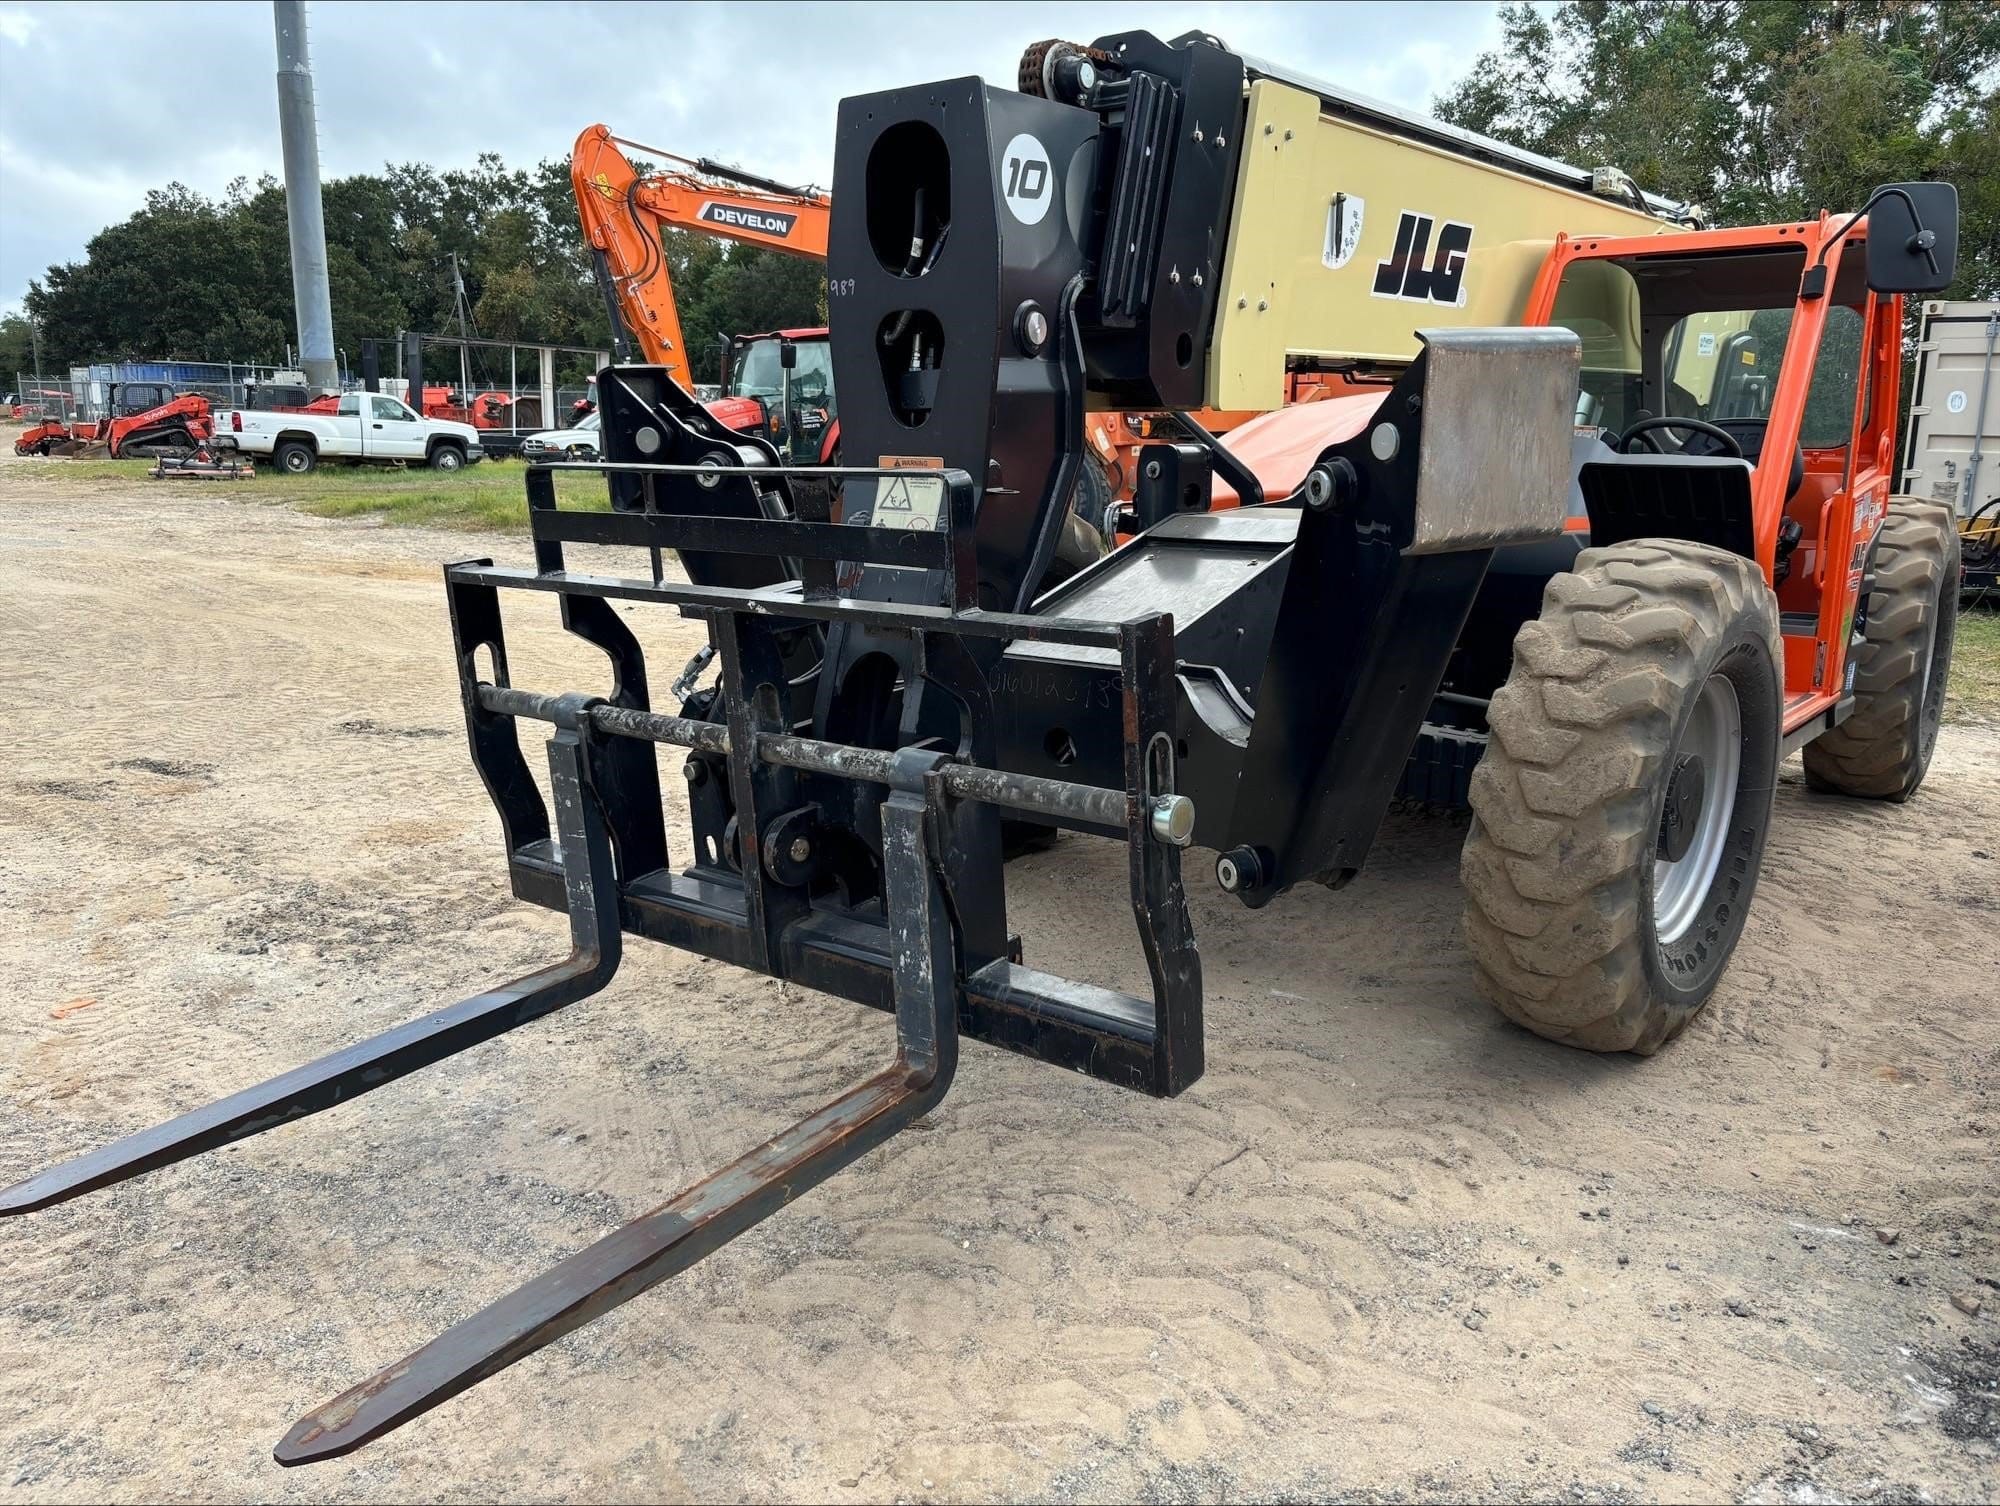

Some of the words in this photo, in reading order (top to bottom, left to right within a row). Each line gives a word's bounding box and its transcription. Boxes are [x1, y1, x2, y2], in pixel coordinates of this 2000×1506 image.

[1007, 157, 1048, 200] 10
[713, 207, 788, 233] DEVELON
[1373, 212, 1473, 303] JLG
[830, 278, 855, 297] 989
